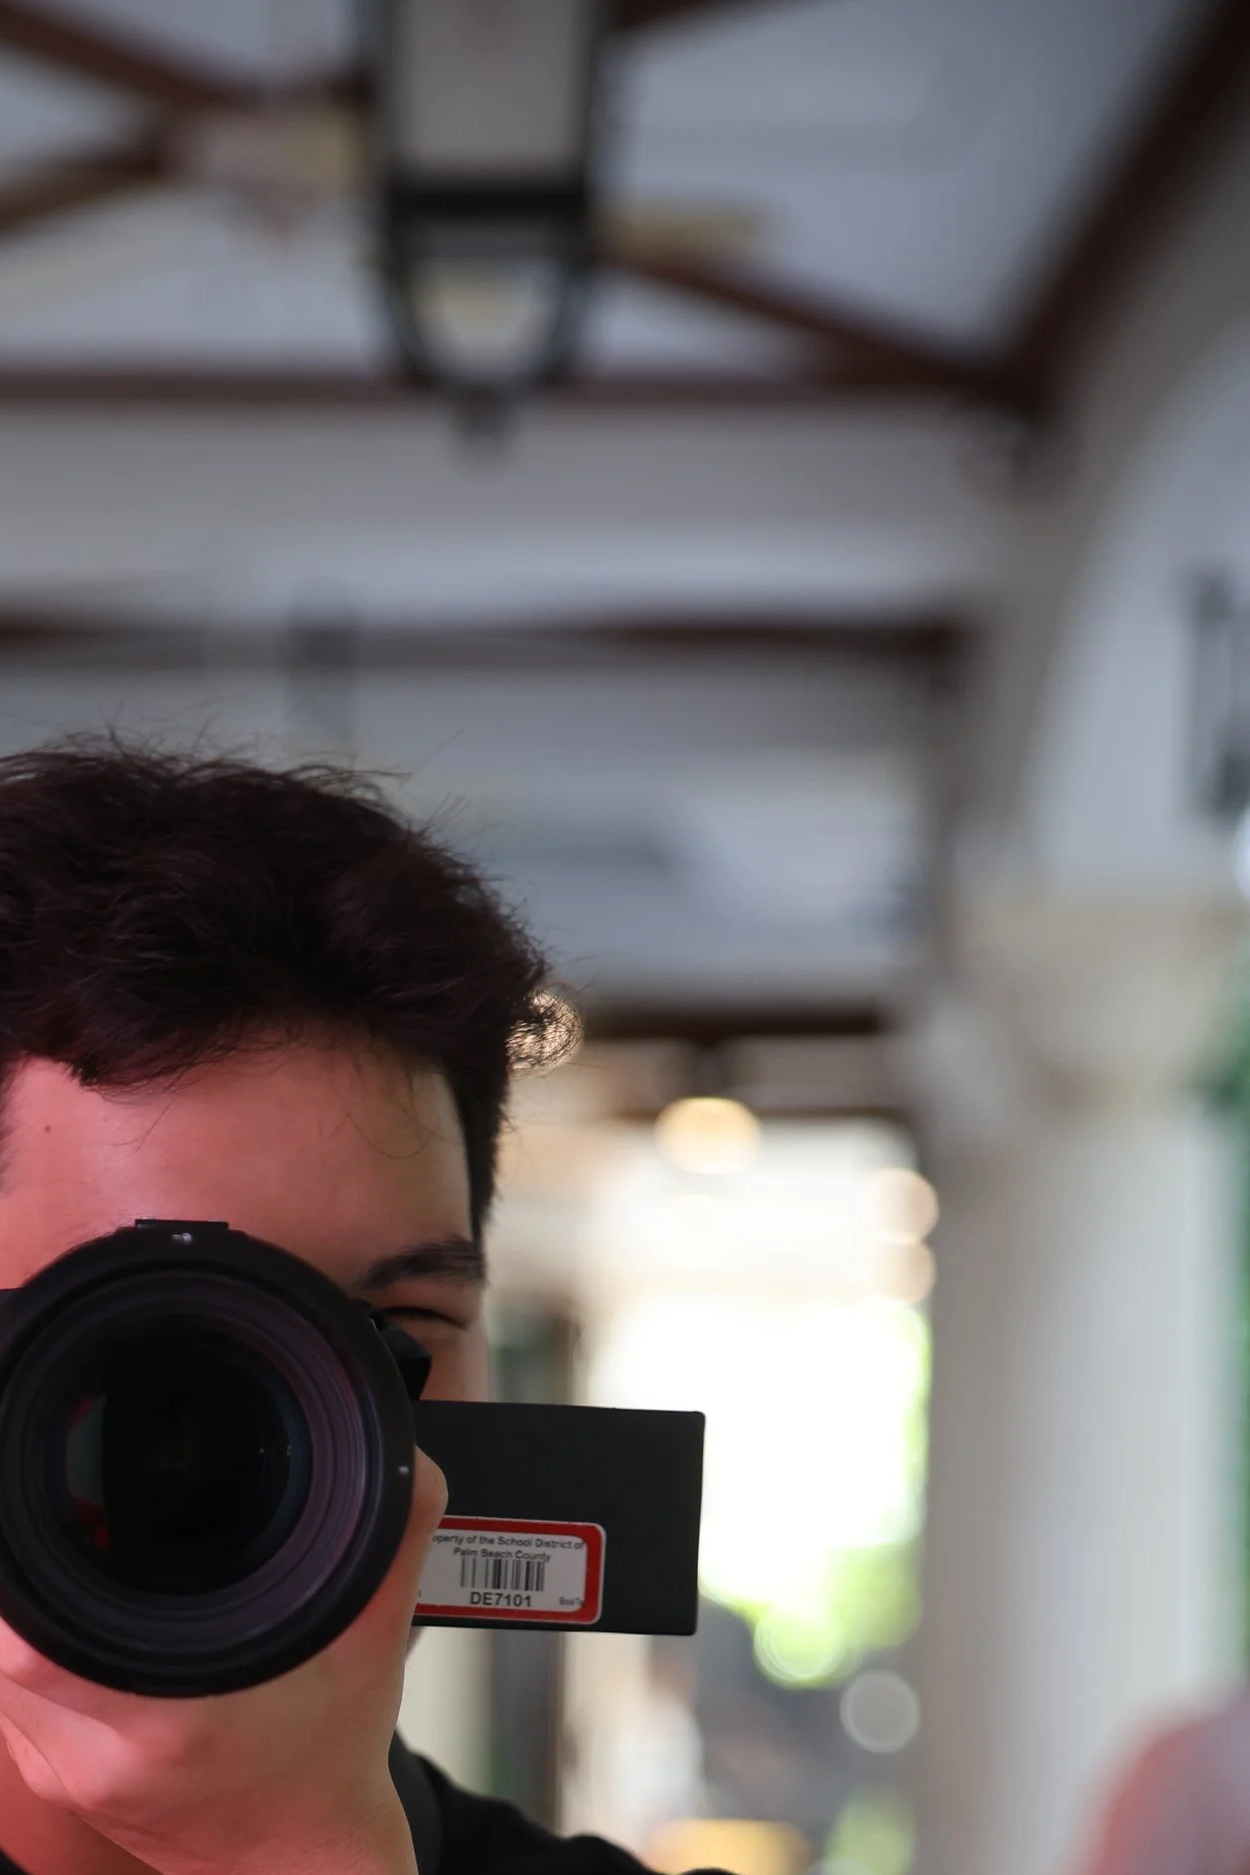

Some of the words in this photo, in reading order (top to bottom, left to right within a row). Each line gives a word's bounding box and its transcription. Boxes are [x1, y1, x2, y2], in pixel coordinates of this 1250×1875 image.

[432, 1534, 464, 1546] operty
[466, 1535, 478, 1545] of
[479, 1536, 495, 1545] the
[498, 1536, 533, 1547] School
[535, 1538, 572, 1549] District
[453, 1547, 478, 1556] Palm
[481, 1549, 512, 1558] Beach
[515, 1550, 552, 1563] County
[470, 1591, 532, 1607] DE7101
